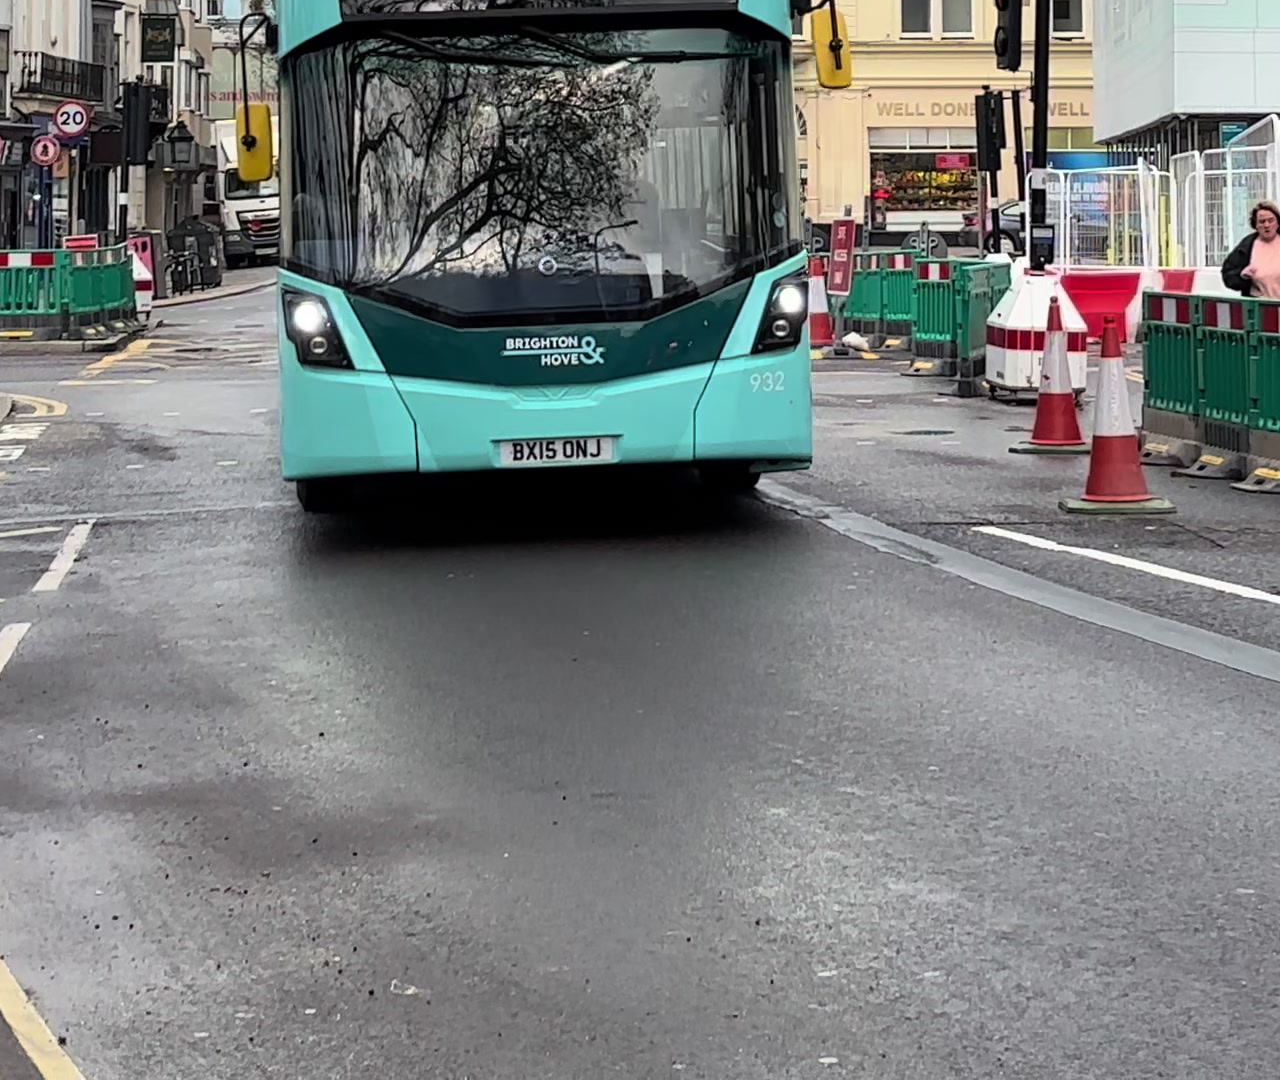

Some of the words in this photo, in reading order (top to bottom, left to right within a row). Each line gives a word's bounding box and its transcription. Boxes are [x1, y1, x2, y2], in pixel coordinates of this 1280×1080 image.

[876, 102, 925, 116] WELL
[60, 111, 84, 126] 20
[505, 335, 578, 349] BRIGHTON
[541, 353, 579, 366] HOVE
[750, 371, 784, 392] 932
[512, 440, 558, 461] BX15
[562, 439, 601, 459] ONJ
